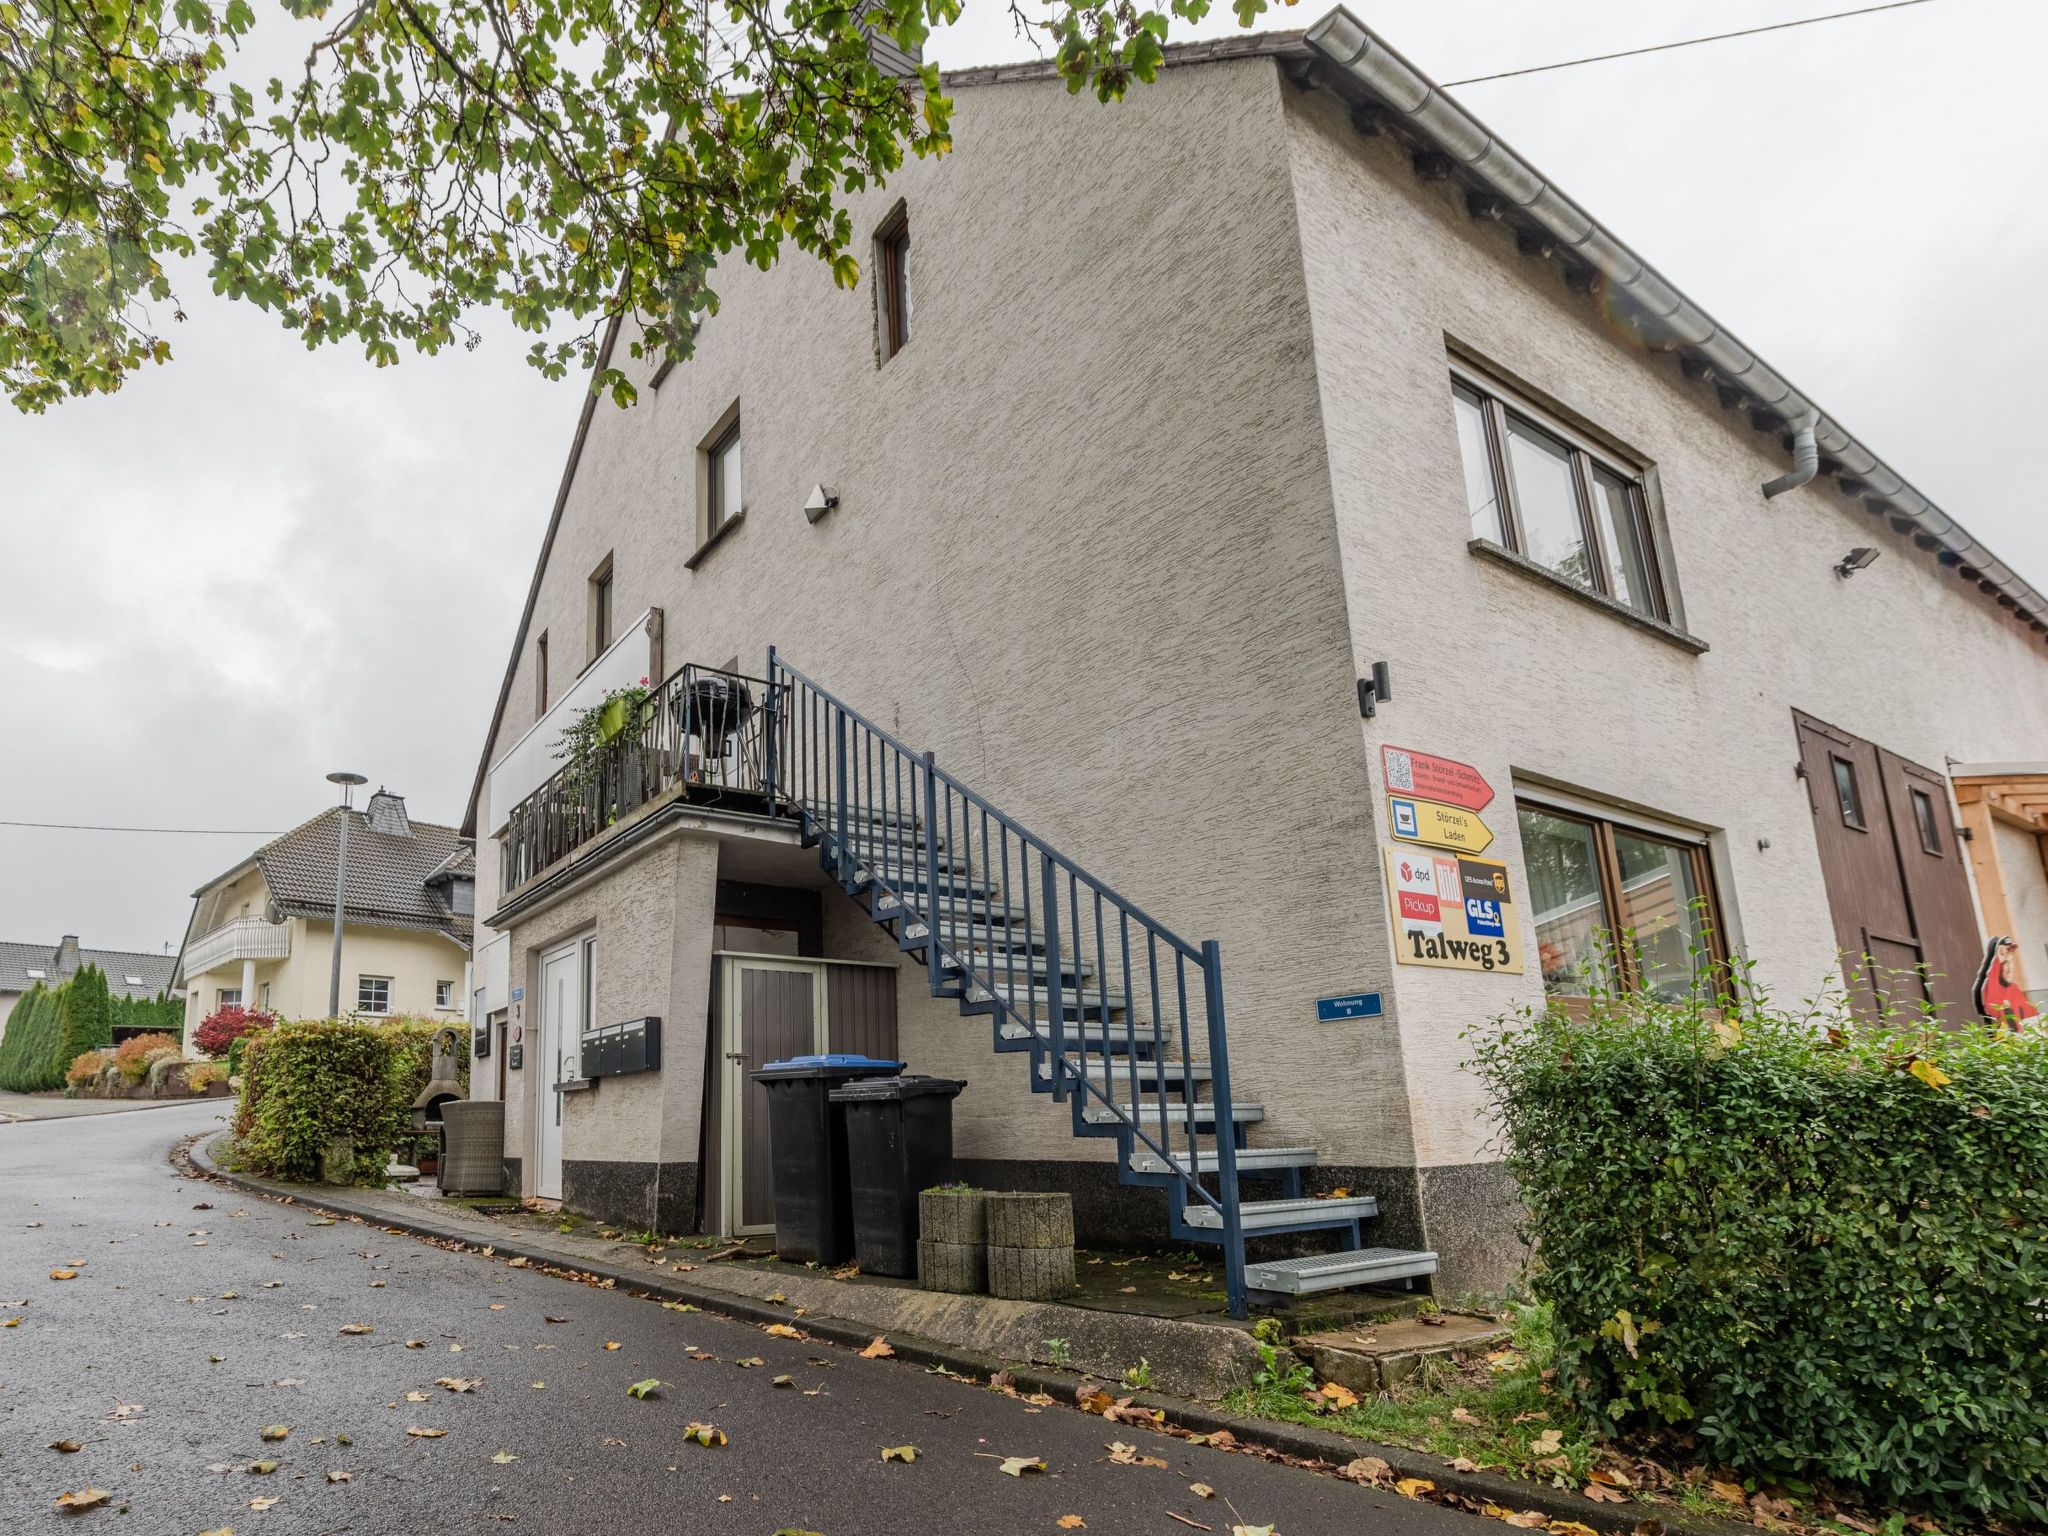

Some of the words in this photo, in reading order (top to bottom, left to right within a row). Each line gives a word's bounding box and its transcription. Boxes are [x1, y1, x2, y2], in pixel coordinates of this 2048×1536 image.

[1437, 811, 1468, 827] Störzel's
[1444, 828, 1466, 842] Laden
[1415, 868, 1430, 882] dpd
[1404, 897, 1435, 915] Pickup
[1467, 899, 1493, 919] GLS
[1408, 929, 1494, 970] Talweg
[1496, 940, 1510, 965] 3
